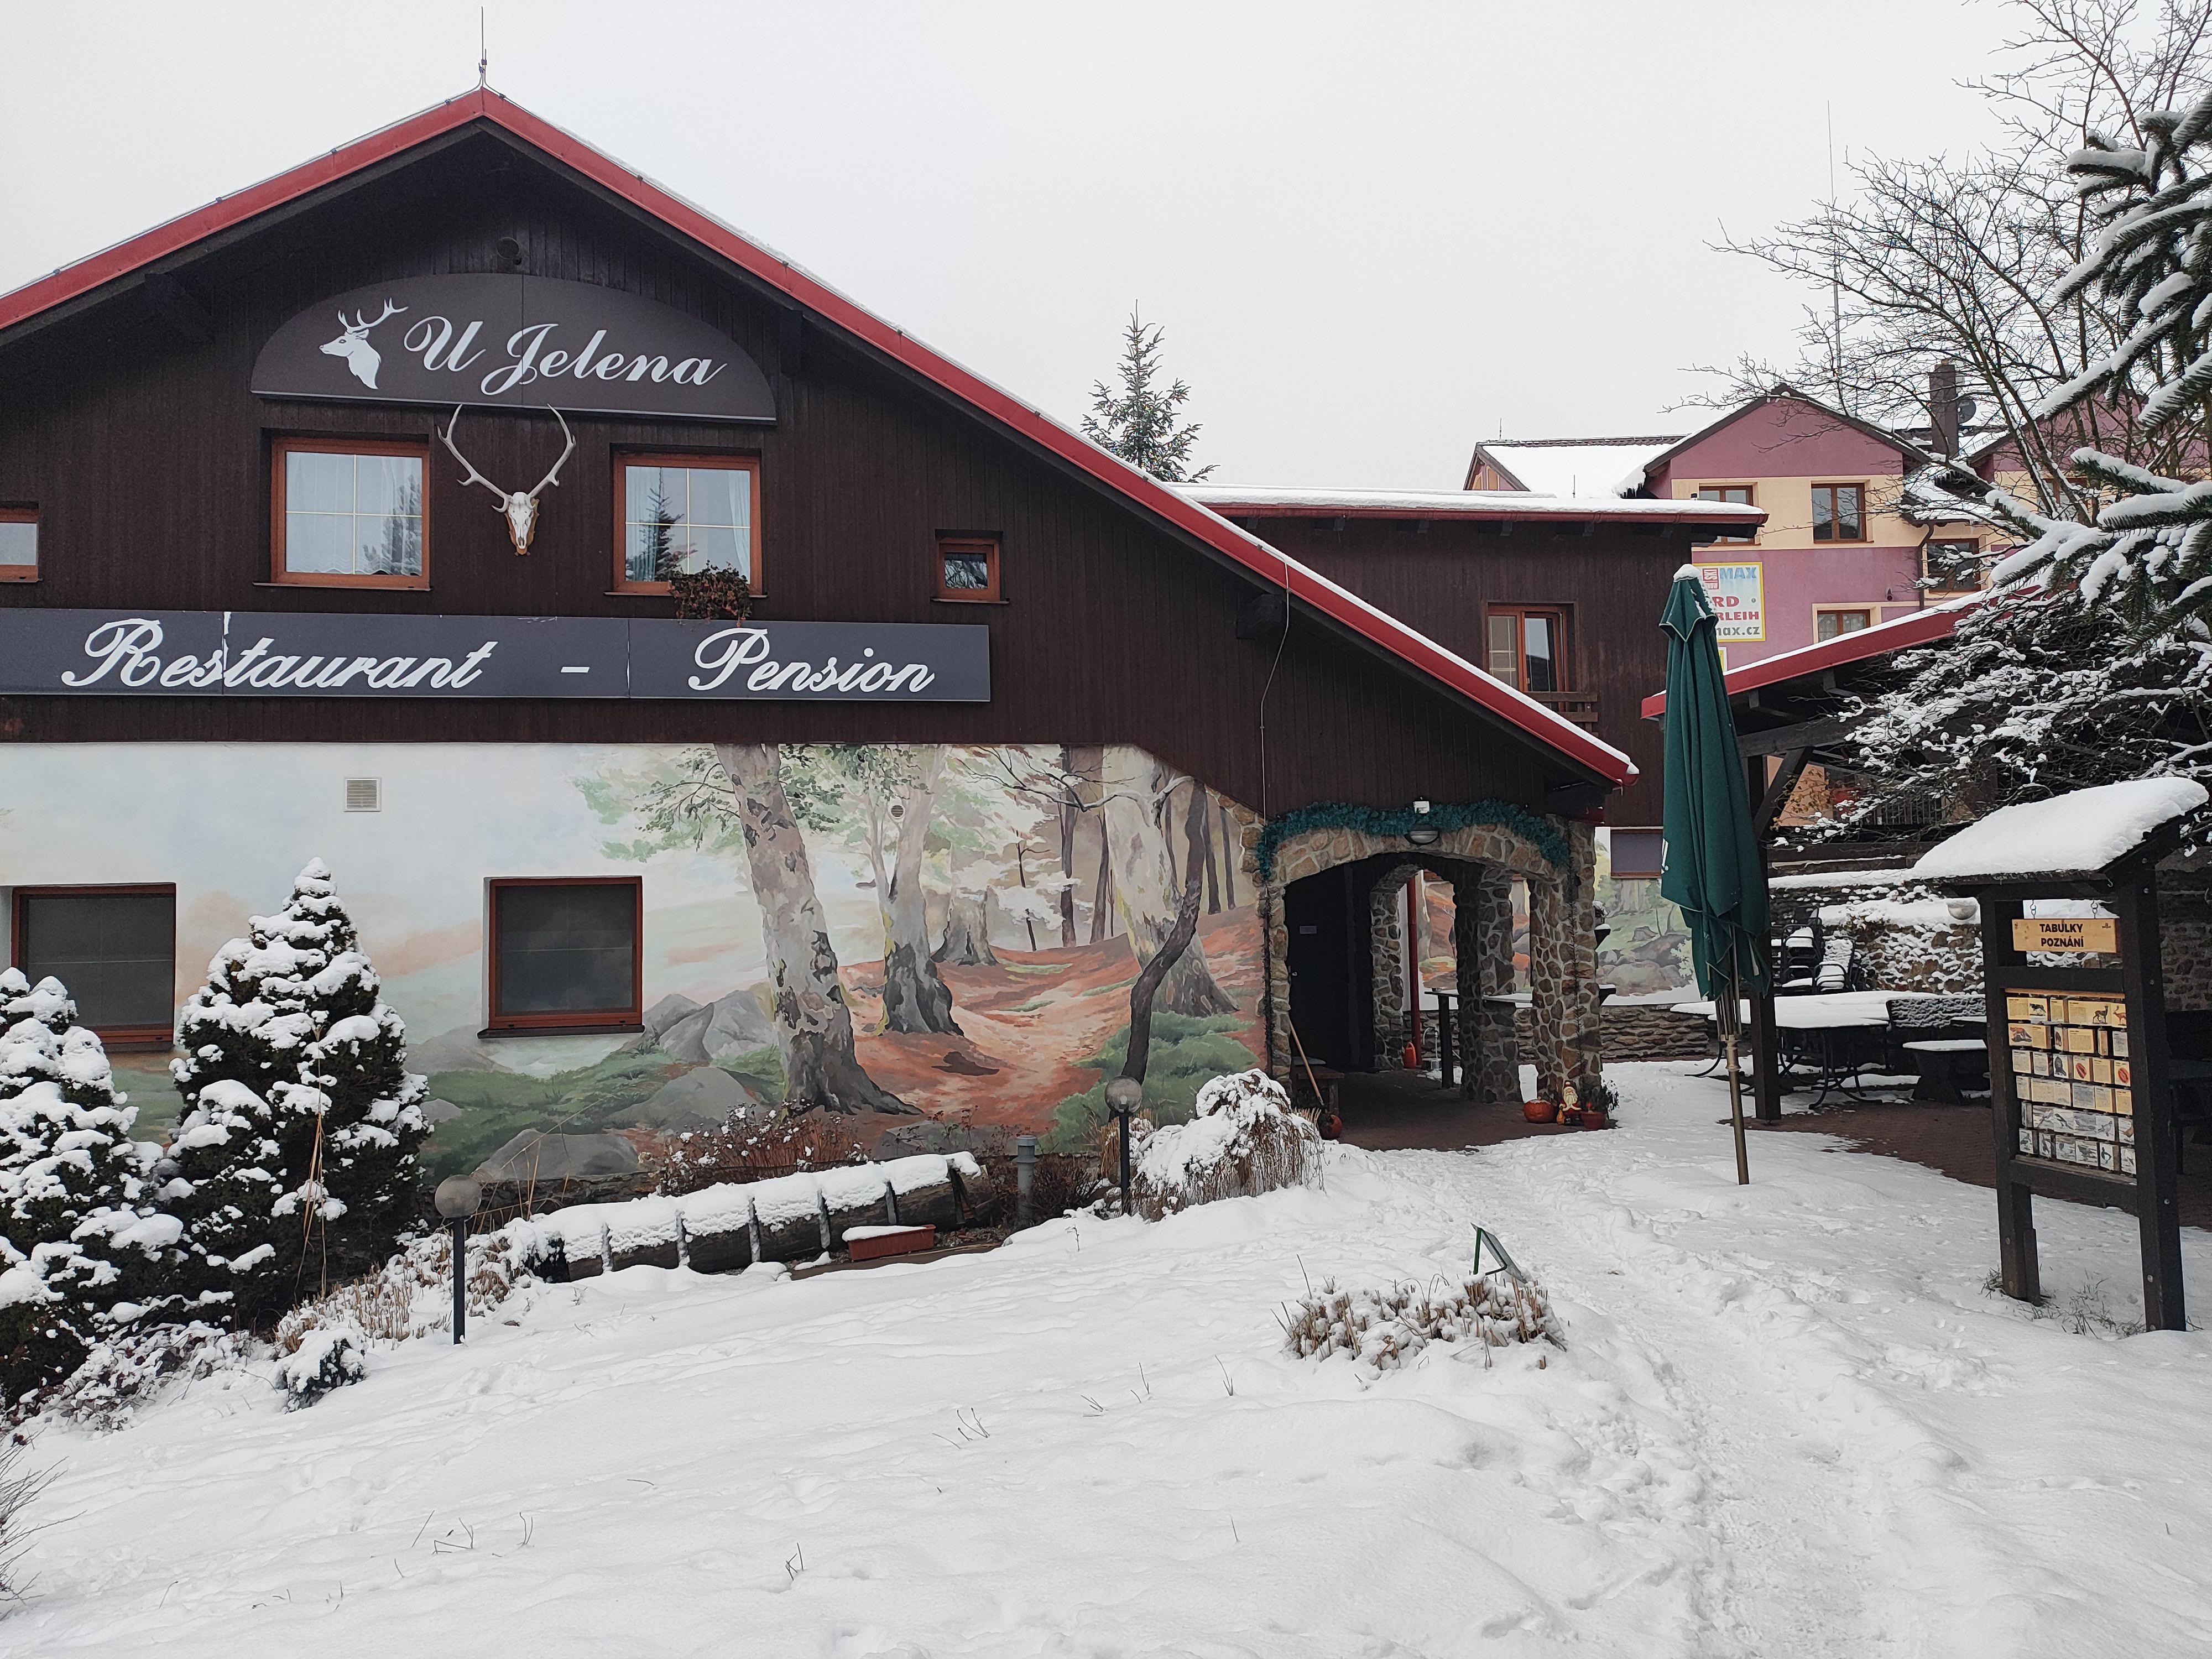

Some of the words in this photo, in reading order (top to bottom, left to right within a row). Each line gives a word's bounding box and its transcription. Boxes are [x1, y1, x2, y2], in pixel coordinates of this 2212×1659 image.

[404, 316, 487, 372] U
[480, 324, 727, 395] Jelena
[1719, 567, 1756, 579] MAX
[61, 618, 498, 688] Restaurant
[688, 627, 935, 692] Pension
[2039, 924, 2083, 933] TABULKY
[2041, 936, 2084, 948] POZNÁNÍ
